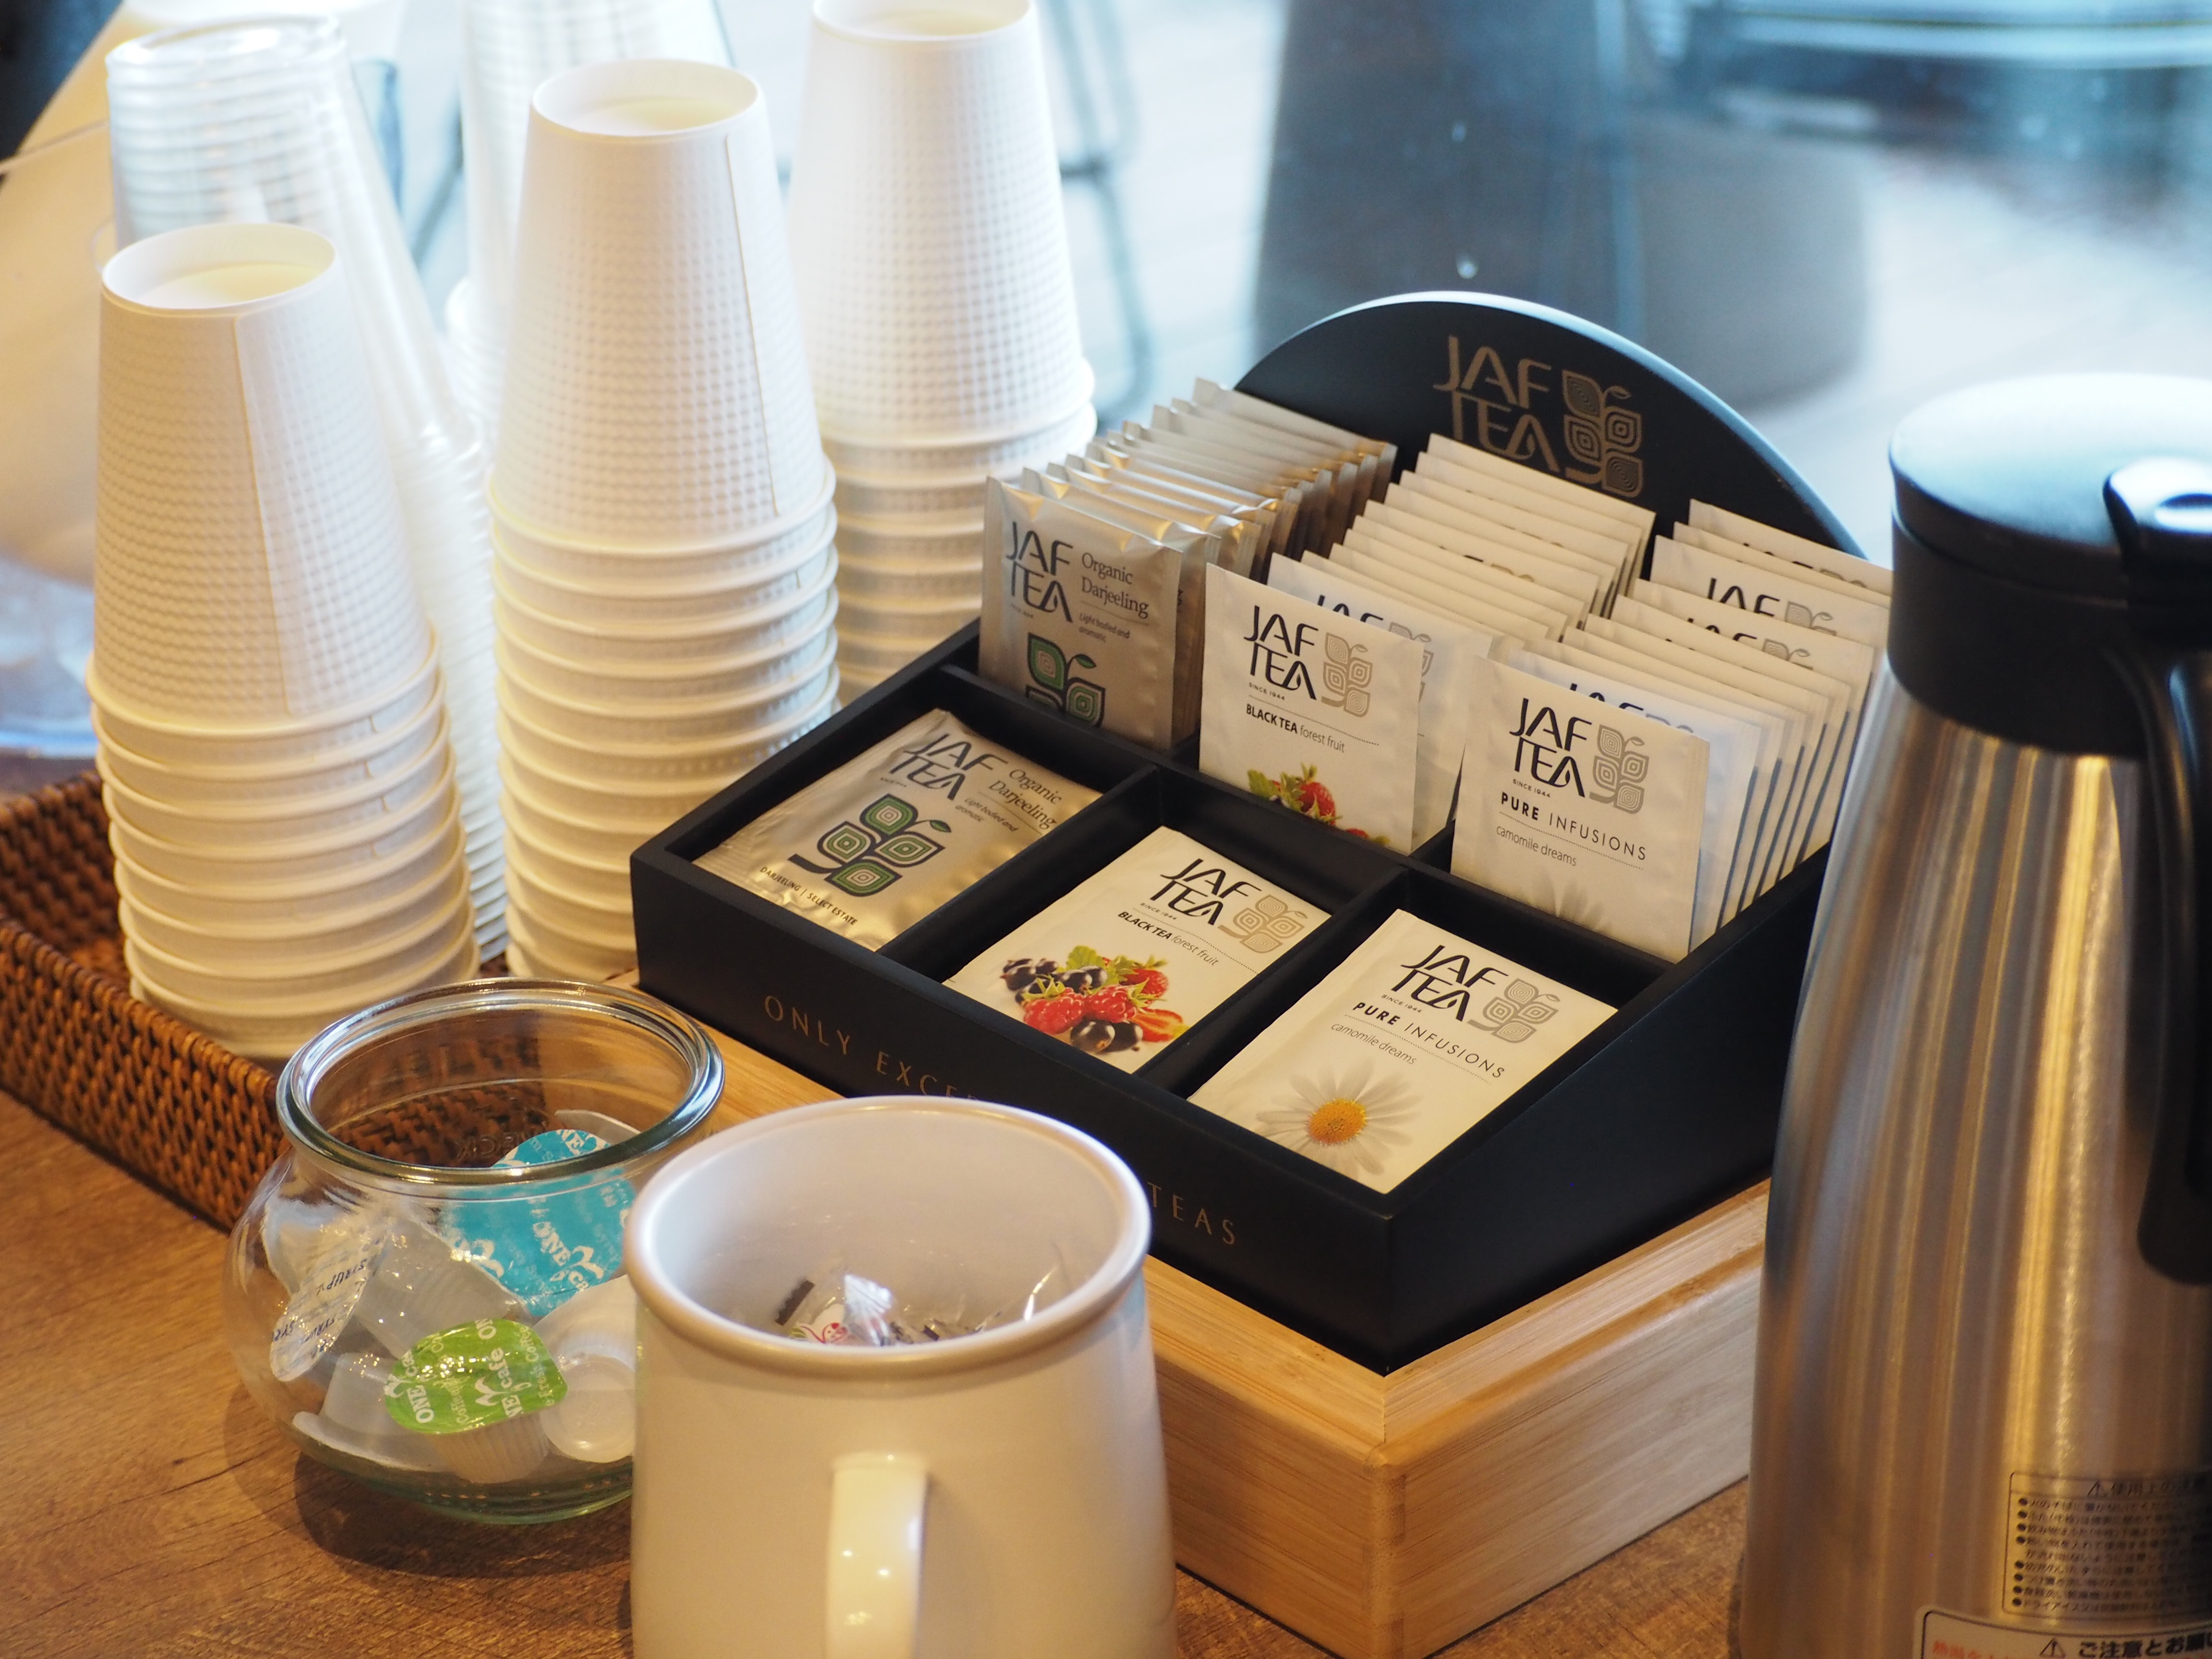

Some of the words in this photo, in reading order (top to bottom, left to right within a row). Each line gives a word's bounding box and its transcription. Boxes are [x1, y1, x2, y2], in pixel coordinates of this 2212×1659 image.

[1433, 335, 1552, 408] JAF
[1451, 388, 1560, 473] TEA
[1006, 521, 1073, 576] JAF
[1082, 552, 1133, 585] Organic
[1011, 562, 1073, 623] TEA
[1082, 577, 1150, 619] Darjeeling
[1244, 605, 1319, 656] JAF
[1249, 682, 1267, 694] SINCE
[1270, 691, 1285, 700] 1944
[1250, 642, 1317, 700] TEA
[1246, 703, 1277, 725] BLACK
[1279, 717, 1297, 734] TEA
[1300, 725, 1325, 745] forest
[1327, 735, 1345, 753] fruit
[1509, 697, 1592, 751] JAF
[903, 733, 1009, 771] JAF
[1515, 736, 1585, 798] TEA
[889, 756, 966, 801] TEA
[1009, 769, 1062, 804] Organic
[1513, 779, 1532, 792] SINCE
[1534, 788, 1551, 798] 1944
[988, 781, 1058, 830] Darjeeling
[1501, 792, 1539, 820] PURE
[1550, 813, 1646, 860] INFUSIONS
[1496, 826, 1539, 852] camomile
[1541, 844, 1576, 866] dreams
[760, 866, 802, 892] DARJEELING
[807, 892, 833, 910] SELECT
[831, 907, 858, 926] ESTATE
[1160, 859, 1262, 898] JAF
[1140, 902, 1160, 913] SINCE
[1162, 912, 1177, 920] 1944
[1150, 880, 1224, 926] TEA
[1118, 911, 1154, 931] BLACK
[1152, 927, 1173, 939] TEA
[1170, 936, 1199, 953] forest
[1197, 950, 1219, 966] fruit
[1400, 945, 1509, 988] JAF
[1381, 994, 1404, 1006] SINCE
[1405, 1004, 1422, 1014] 1944
[1391, 969, 1470, 1022] TEA
[1331, 1023, 1379, 1046] camomile
[1379, 1039, 1417, 1065] dreams
[1352, 1002, 1401, 1025] PURE
[1404, 1022, 1505, 1078] INFUSIONS
[765, 995, 850, 1055] ONLY
[1147, 1181, 1236, 1245] TEAS
[532, 1222, 571, 1266] ONE
[326, 1258, 367, 1290] SYRUP
[407, 1385, 434, 1424] ONE
